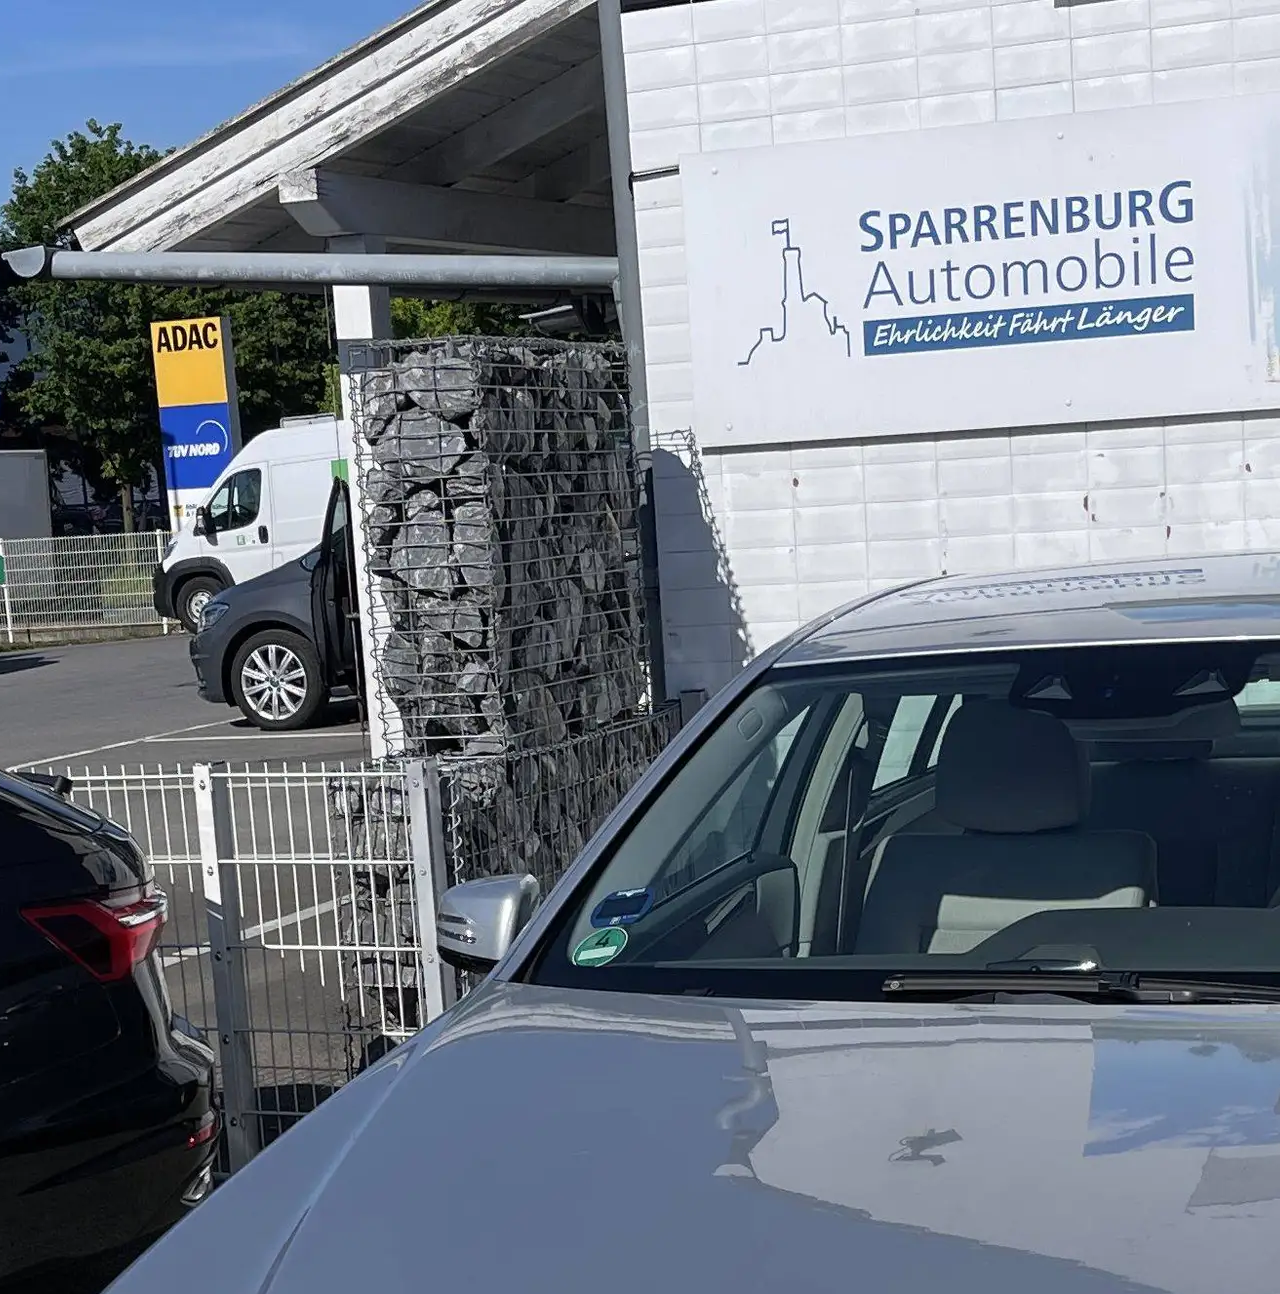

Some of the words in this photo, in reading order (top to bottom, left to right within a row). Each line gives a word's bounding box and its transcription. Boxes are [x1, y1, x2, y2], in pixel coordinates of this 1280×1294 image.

[859, 180, 1194, 253] SPARRENBURG
[862, 233, 1195, 310] Automobile
[156, 322, 218, 353] ADAC
[873, 315, 1006, 347] Ehrlichkeit
[1008, 310, 1074, 336] Fährt
[1077, 303, 1185, 331] Länger
[189, 442, 220, 456] NORD
[595, 929, 611, 947] 4
